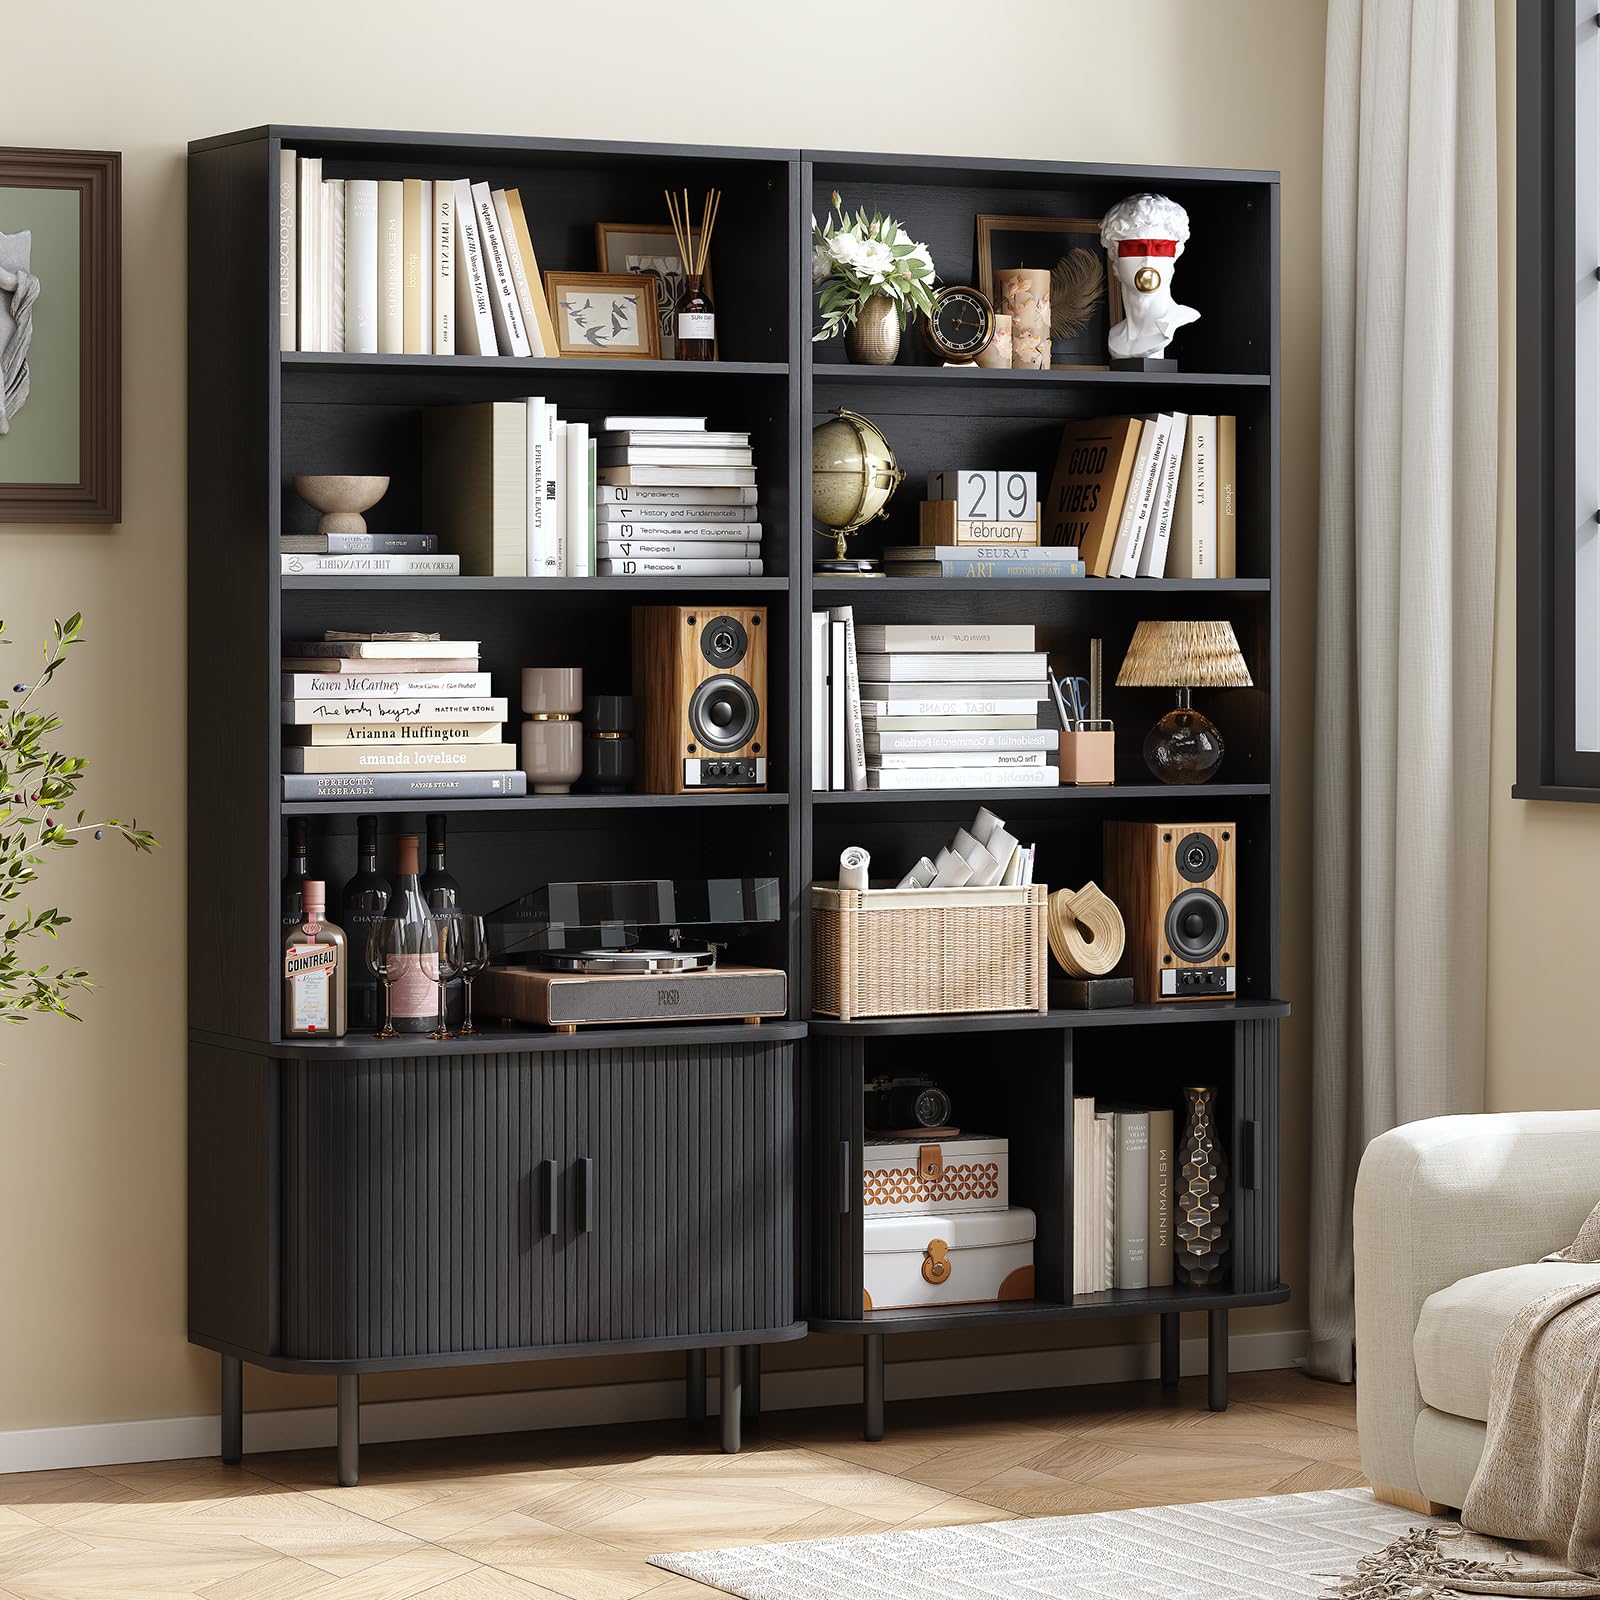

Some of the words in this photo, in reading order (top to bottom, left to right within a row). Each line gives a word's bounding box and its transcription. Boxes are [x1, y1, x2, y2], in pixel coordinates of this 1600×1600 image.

[1198, 436, 1204, 448] ON
[1069, 447, 1108, 475] GOOD
[1144, 462, 1158, 502] sustainable
[1153, 434, 1164, 461] lifestyle
[547, 481, 555, 500] PEOPLE
[616, 488, 628, 500] 2
[1058, 484, 1100, 512] VIBES
[1160, 508, 1169, 538] DREAM
[1168, 454, 1177, 482] AWAKE
[621, 524, 633, 537] 3
[969, 522, 1022, 541] february
[1054, 521, 1090, 550] ONLY
[620, 543, 631, 556] 4
[977, 549, 1029, 558] SEURAT
[623, 561, 636, 574] 5
[966, 562, 994, 577] ART
[311, 678, 341, 691] Karen
[344, 678, 399, 694] McCartney
[313, 705, 340, 717] The
[344, 702, 371, 716] body
[378, 704, 420, 722] beyond
[347, 727, 396, 739] Arianna
[401, 726, 469, 741] Huffington
[360, 753, 410, 765] amanda
[414, 752, 466, 764] lovelace
[318, 777, 374, 786] PERFECTLY
[318, 787, 374, 795] MISERABLE
[288, 950, 334, 973] COINTREAU
